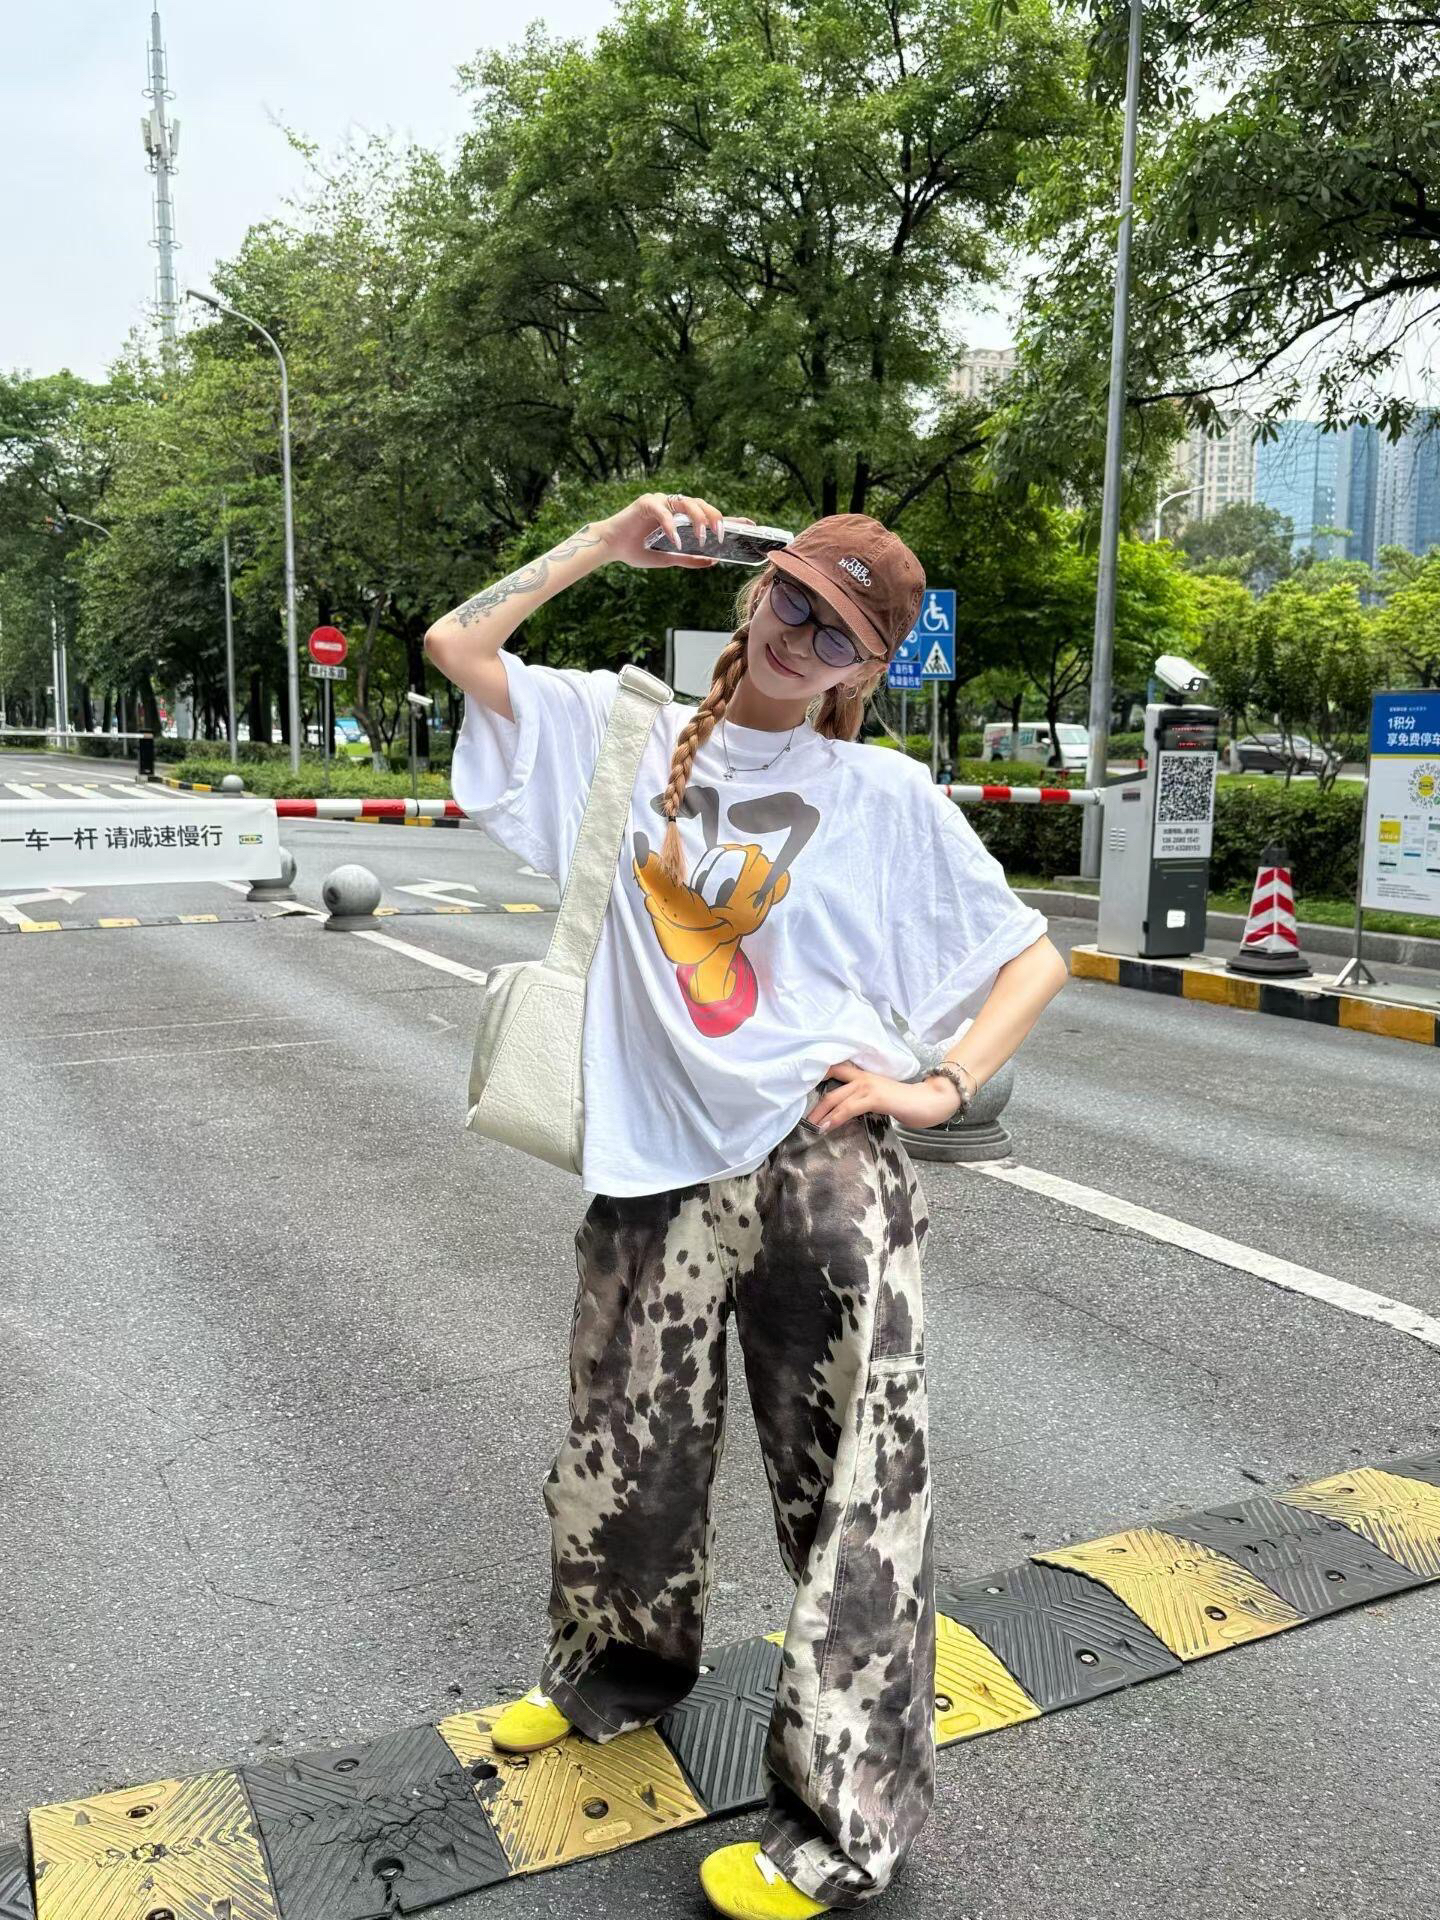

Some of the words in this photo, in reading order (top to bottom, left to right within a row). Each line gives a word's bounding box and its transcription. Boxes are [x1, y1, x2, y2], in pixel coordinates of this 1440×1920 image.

[838, 557, 872, 587] HOBOO
[850, 557, 870, 577] THE
[1387, 716, 1416, 730] 1积分
[1386, 732, 1440, 747] 享免费停车
[1, 827, 98, 851] 一车一杆
[105, 825, 223, 849] 请减速慢行
